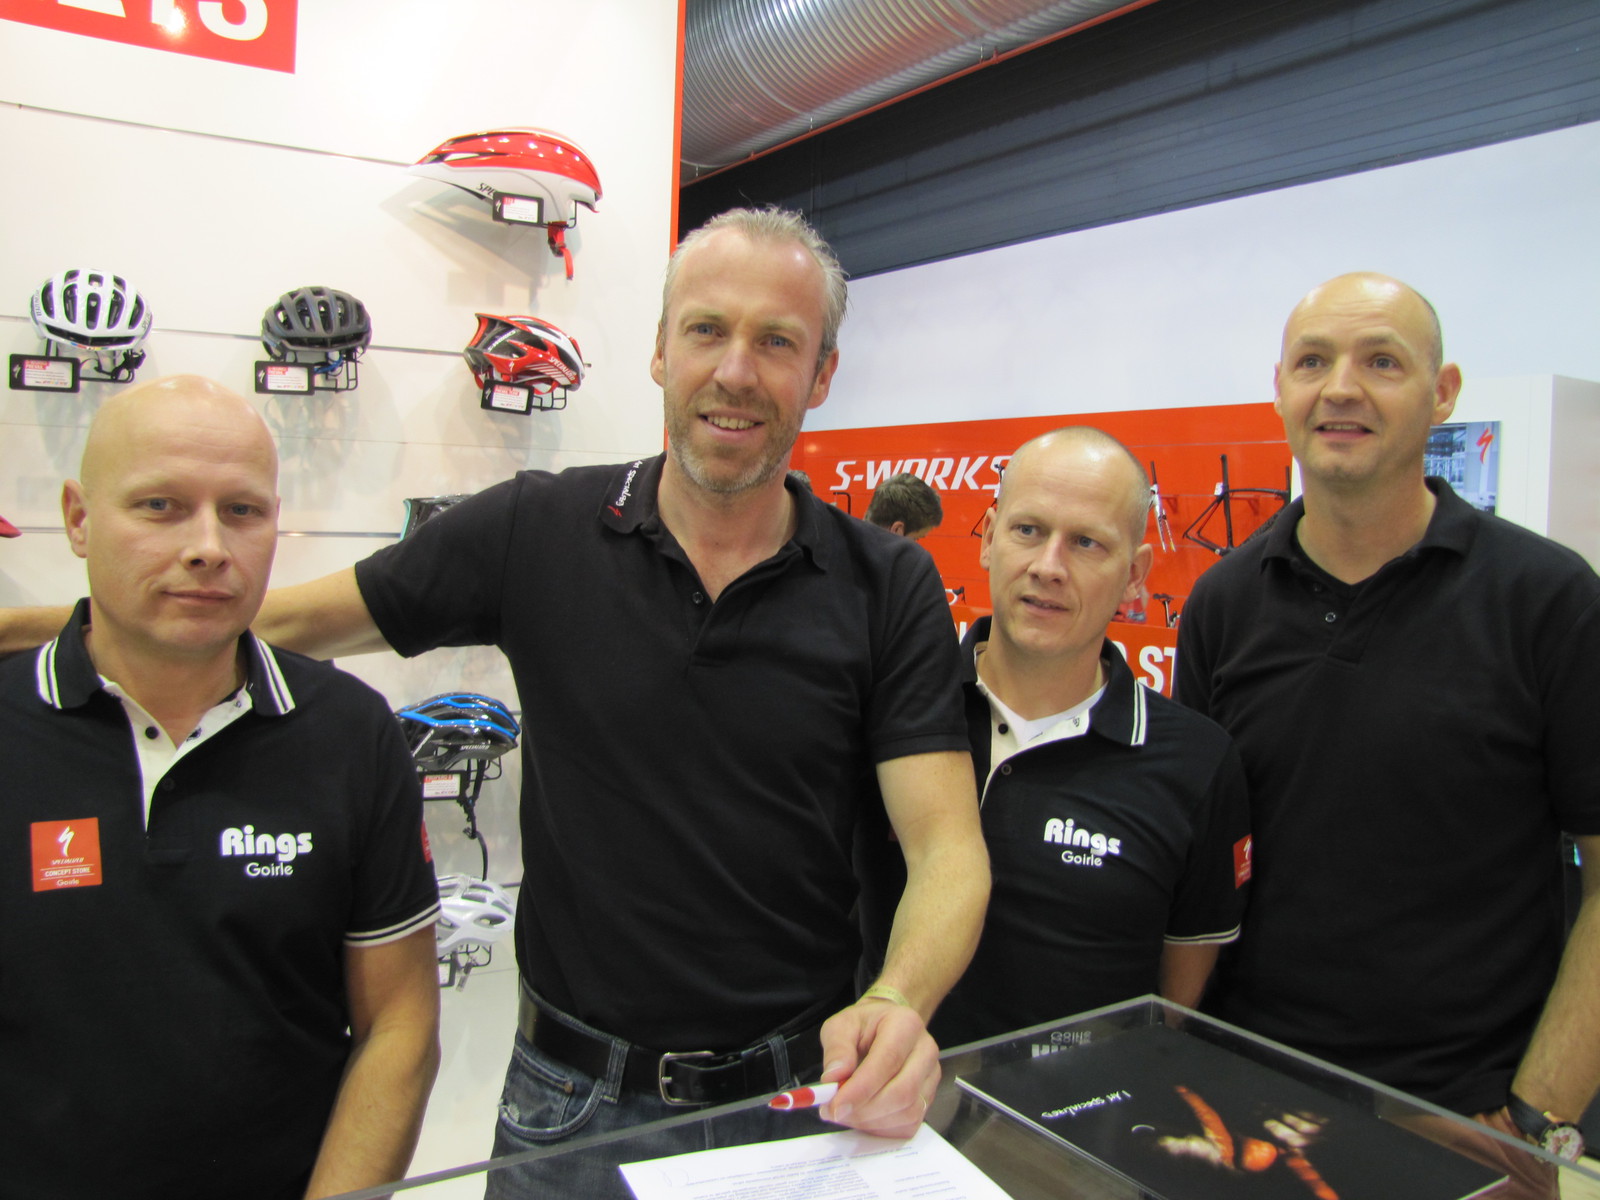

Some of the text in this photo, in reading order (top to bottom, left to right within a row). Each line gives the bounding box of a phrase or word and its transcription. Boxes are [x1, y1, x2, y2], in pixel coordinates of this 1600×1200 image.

[221, 824, 313, 862] Rings
[1043, 817, 1121, 857] Rings
[1061, 850, 1103, 867] Goirle
[44, 867, 91, 877] CONCEPT STORE
[246, 862, 294, 877] Goirle
